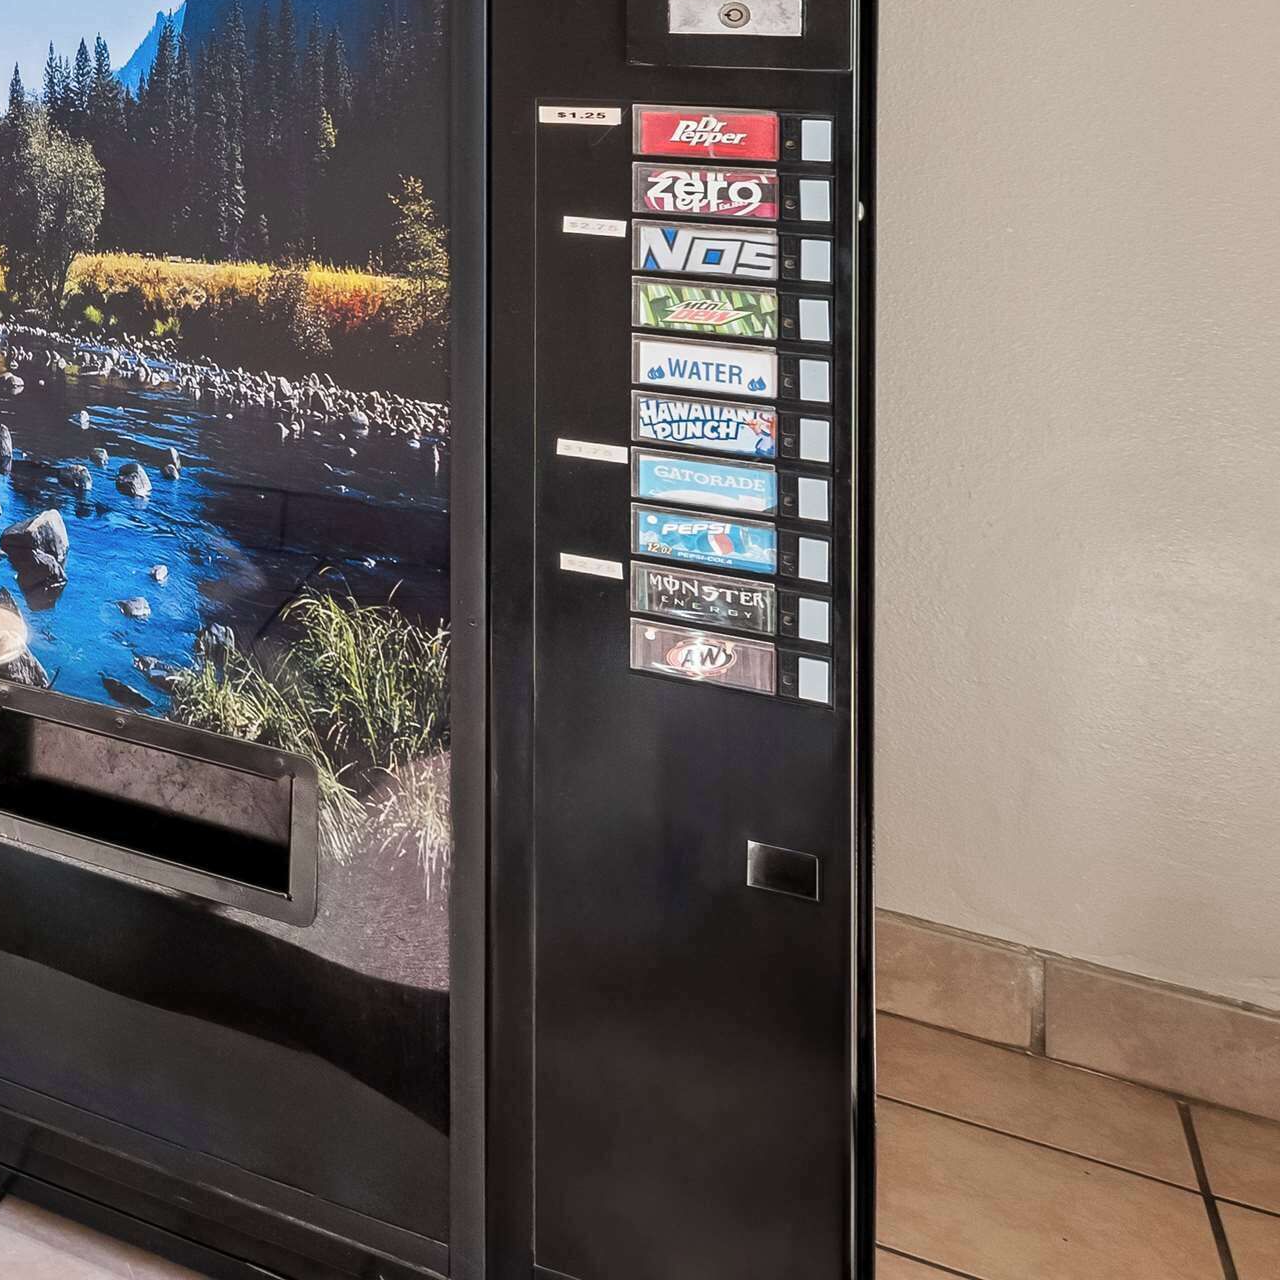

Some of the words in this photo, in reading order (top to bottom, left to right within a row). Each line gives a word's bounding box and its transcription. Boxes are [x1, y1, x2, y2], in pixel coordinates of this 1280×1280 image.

[556, 111, 607, 120] $1.25
[698, 116, 727, 134] Dr
[670, 119, 747, 146] Pepper
[640, 226, 778, 278] NOS
[666, 357, 743, 385] WATER
[640, 398, 763, 426] HAWAIIAN
[652, 420, 740, 441] PUNCH
[653, 464, 766, 492] GATORADE
[661, 523, 733, 535] PEPSI
[647, 542, 659, 553] 12
[677, 551, 734, 565] PEPSI-COLA
[648, 572, 765, 608] MONSTER
[661, 594, 753, 619] ENERGY
